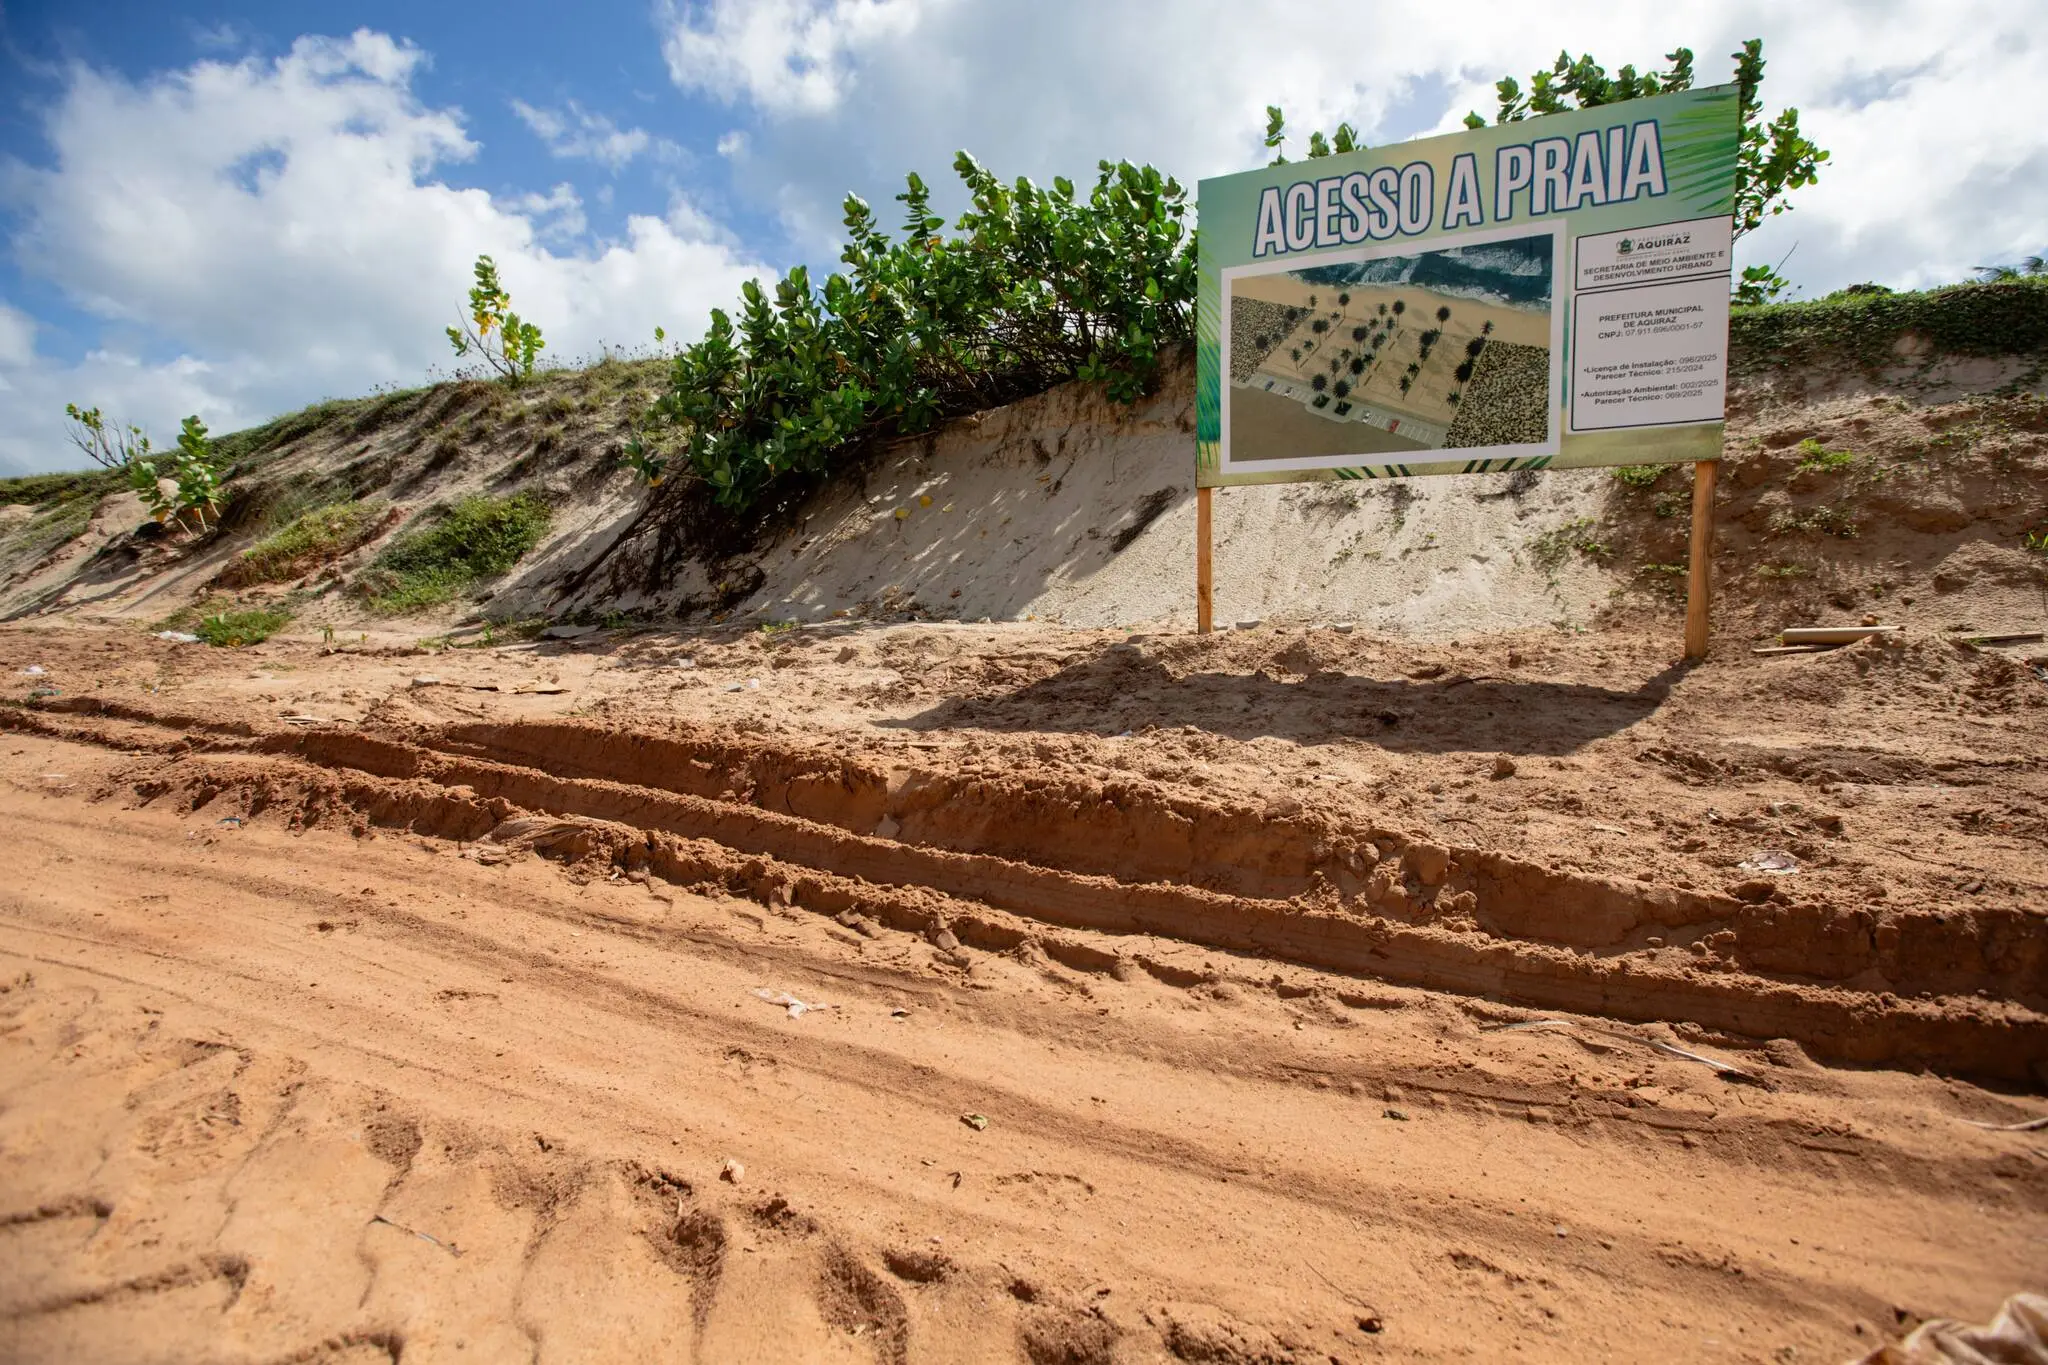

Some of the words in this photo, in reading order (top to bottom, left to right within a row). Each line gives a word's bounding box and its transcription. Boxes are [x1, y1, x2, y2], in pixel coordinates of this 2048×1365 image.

[1253, 161, 1434, 258] ACESSO
[1442, 153, 1483, 230] A
[1494, 119, 1668, 222] PRAIA
[1637, 236, 1691, 250] AQUIRAZ
[1584, 263, 1634, 276] SECRETARIA
[1636, 261, 1648, 269] DE
[1649, 258, 1671, 266] MEIO
[1672, 252, 1715, 263] AMBIENTE
[1593, 265, 1674, 282] DESENVOLVIMENTO
[1675, 260, 1713, 272] URBANO
[1599, 311, 1654, 322] PREFEITURA
[1655, 305, 1704, 316] MUNICIPAL
[1623, 320, 1635, 328] DE
[1637, 316, 1677, 327] AQUIRAZ
[1598, 330, 1623, 339] CNPJ:
[1631, 359, 1677, 369] Instalação:
[1595, 372, 1626, 380] Parecer
[1628, 368, 1664, 378] Técnico:
[1632, 383, 1678, 394] Ambiental:
[1594, 397, 1626, 405] Parecer
[1628, 393, 1663, 402] Técnico:
